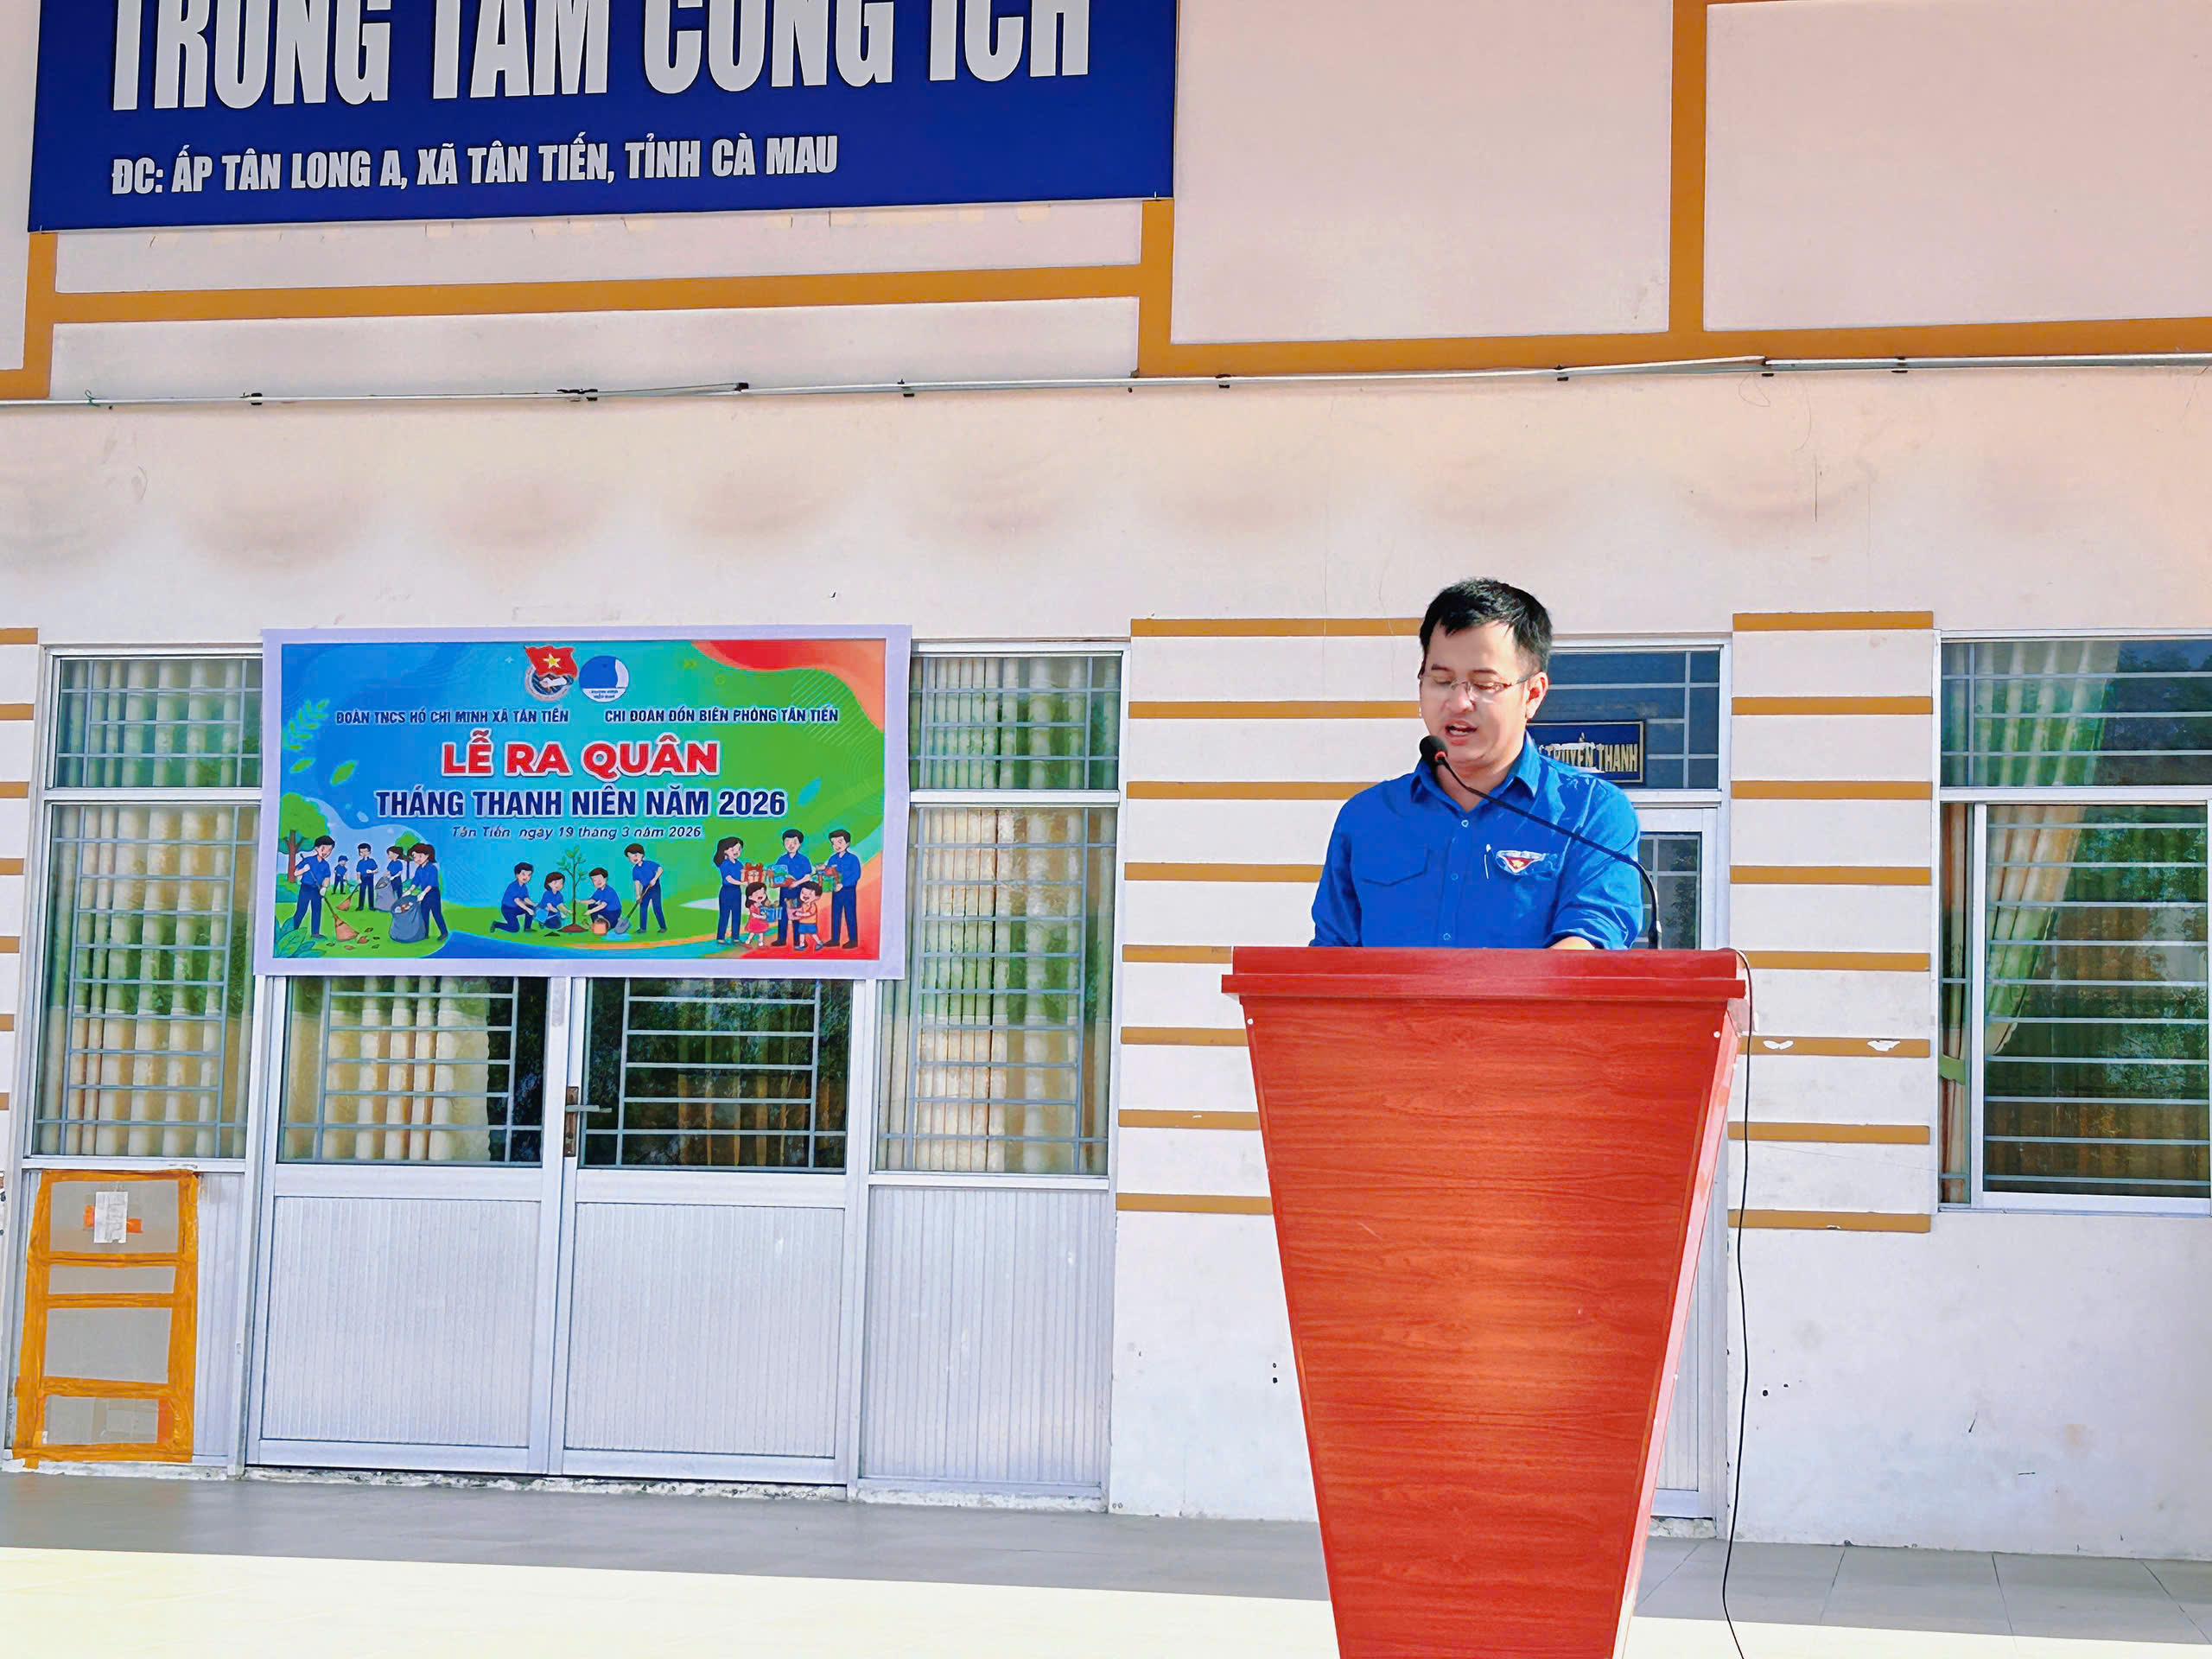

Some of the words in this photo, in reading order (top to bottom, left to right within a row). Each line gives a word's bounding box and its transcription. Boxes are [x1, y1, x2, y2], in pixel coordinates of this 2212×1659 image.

[111, 156, 163, 194] ĐC:
[171, 144, 213, 192] ẤP
[222, 147, 282, 191] TÂN
[290, 150, 371, 189] LONG
[379, 149, 408, 190] A,
[417, 143, 459, 186] XÃ
[467, 140, 529, 183] TÂN
[538, 131, 615, 184] TIẾN,
[625, 132, 701, 178] TỈNH
[712, 132, 756, 177] CÀ
[766, 136, 838, 175] MAU
[374, 711, 406, 724] TNCS
[455, 711, 488, 723] MINH
[605, 709, 626, 722] CHI
[699, 707, 728, 722] BIÊN
[443, 729, 492, 774] LỄ
[506, 743, 570, 774] RA
[582, 734, 718, 779] QUÂN
[1596, 743, 1638, 772] THANH
[376, 785, 464, 816] THÁNG
[473, 791, 562, 816] THANH
[572, 785, 636, 816] NIÊN
[646, 785, 709, 816] NĂM
[718, 791, 785, 816] 2026
[559, 826, 574, 837] 19
[578, 826, 617, 841] tháng
[621, 826, 630, 837] 3
[668, 826, 702, 837] 2026
